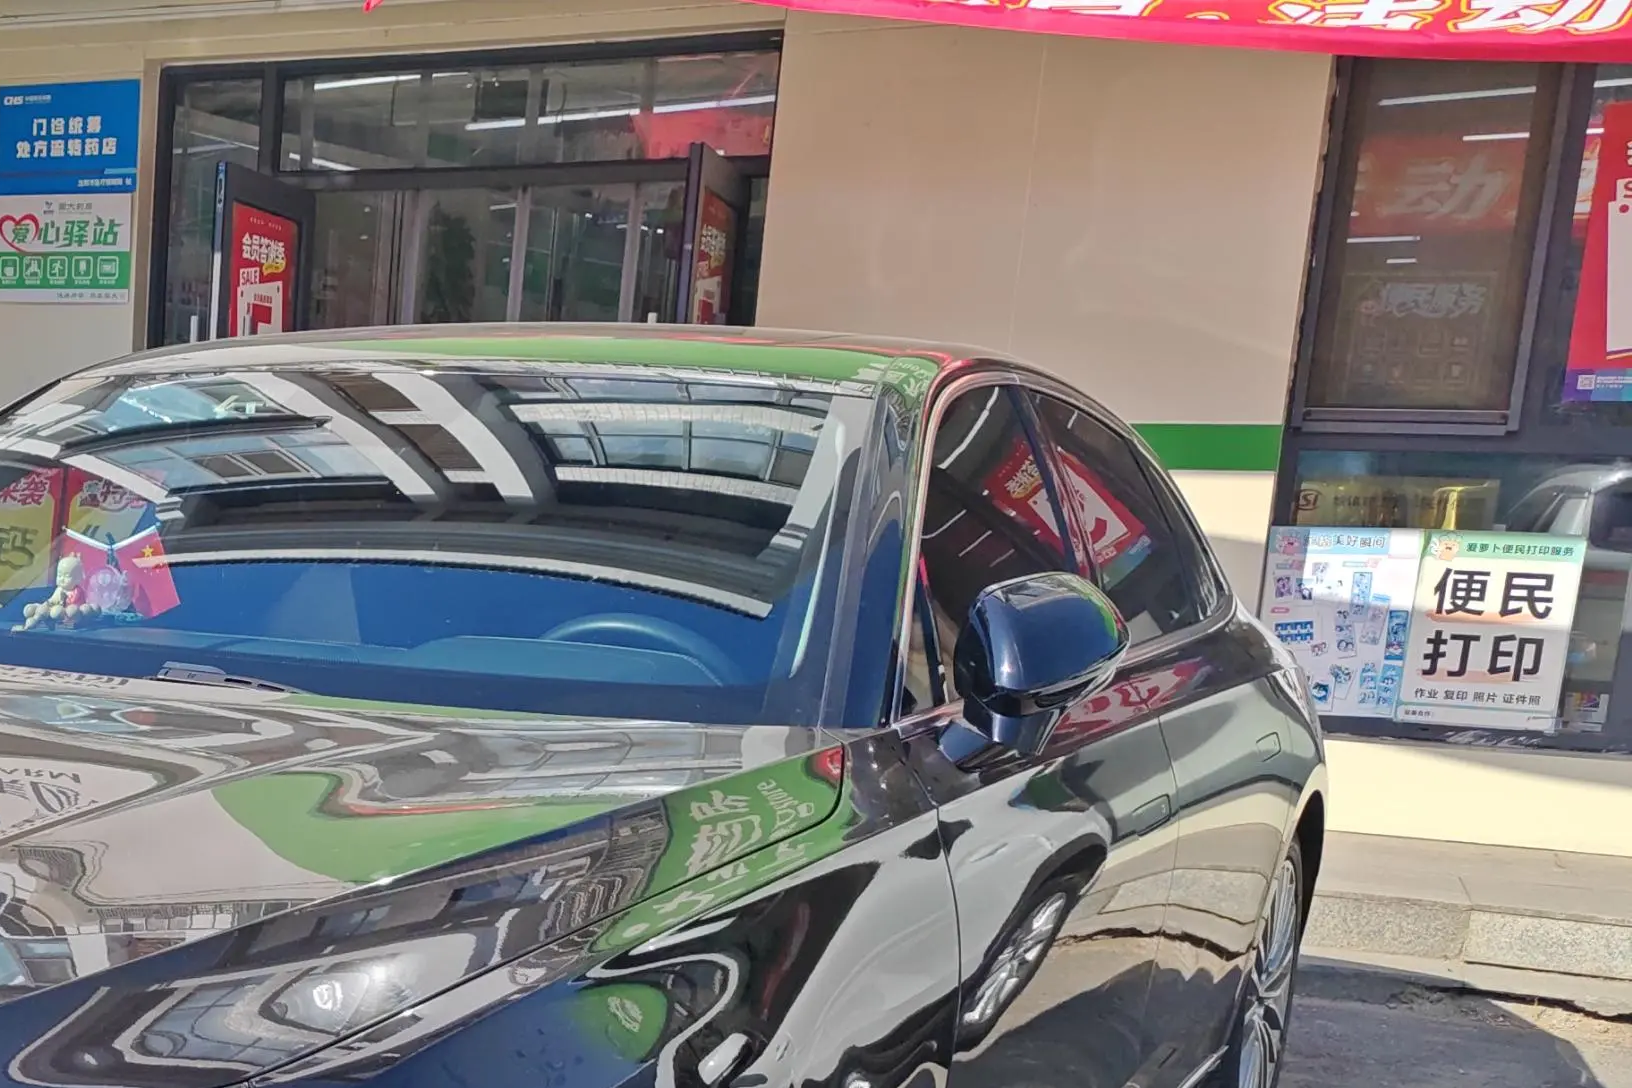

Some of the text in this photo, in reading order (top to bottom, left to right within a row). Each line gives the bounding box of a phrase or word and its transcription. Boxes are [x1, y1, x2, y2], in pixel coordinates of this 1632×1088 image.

[11, 215, 125, 249] 爱心驿站
[240, 270, 259, 286] SALE
[1433, 567, 1555, 620] 便民
[1420, 629, 1545, 682] 打印
[1414, 687, 1541, 706] 作业 复印 照片 证件照
